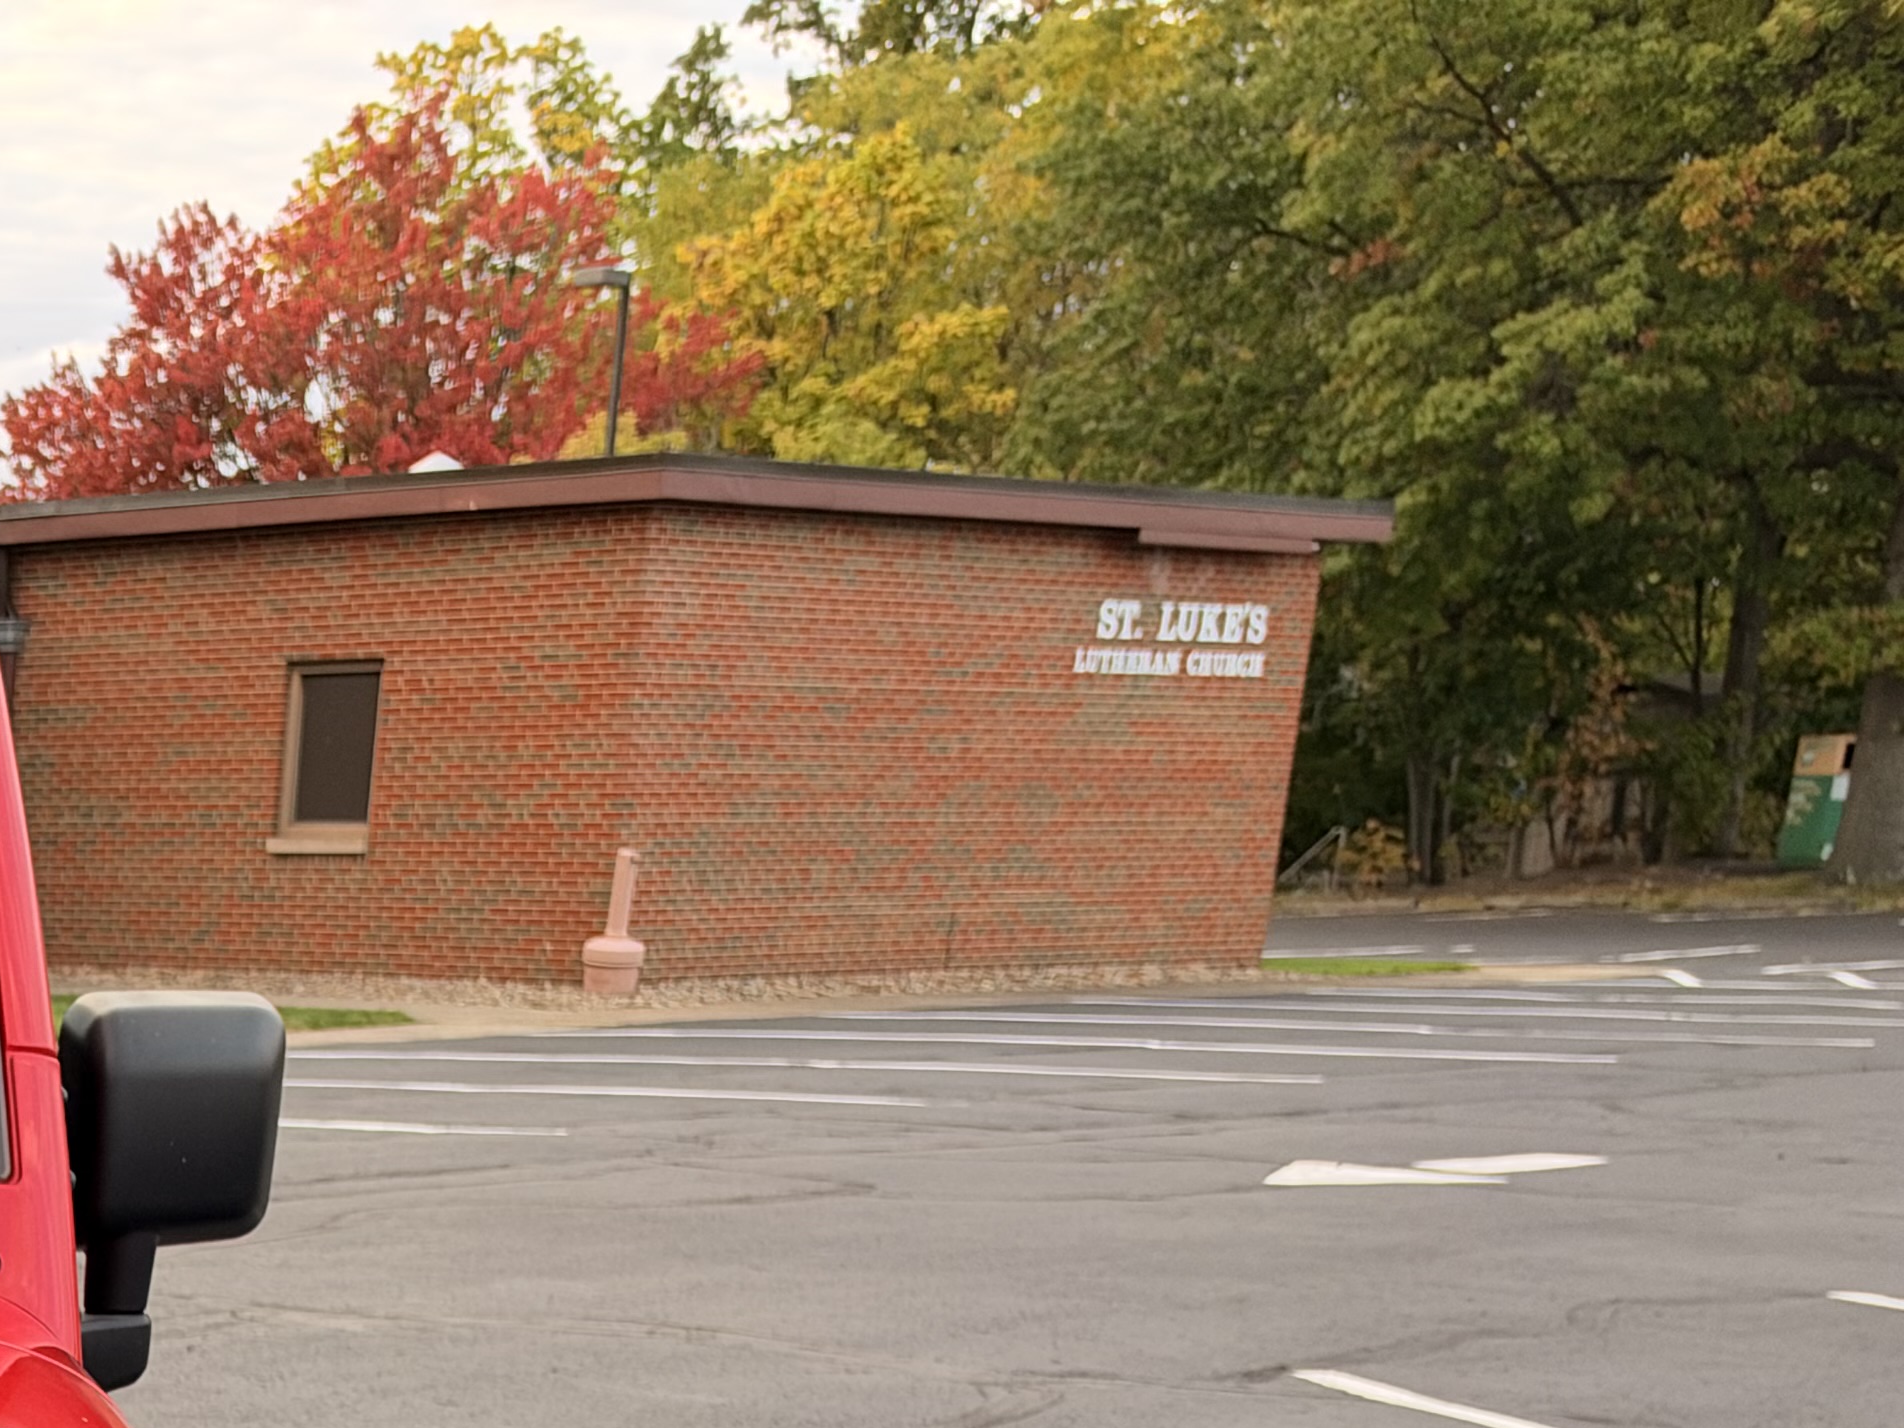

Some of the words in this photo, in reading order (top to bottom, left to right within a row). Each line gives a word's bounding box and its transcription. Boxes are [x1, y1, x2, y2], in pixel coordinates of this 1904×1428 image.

[1096, 598, 1143, 640] ST.
[1156, 601, 1269, 645] LUKE'S
[1072, 646, 1182, 676] LUTHERAN
[1186, 650, 1266, 678] CHURCH
